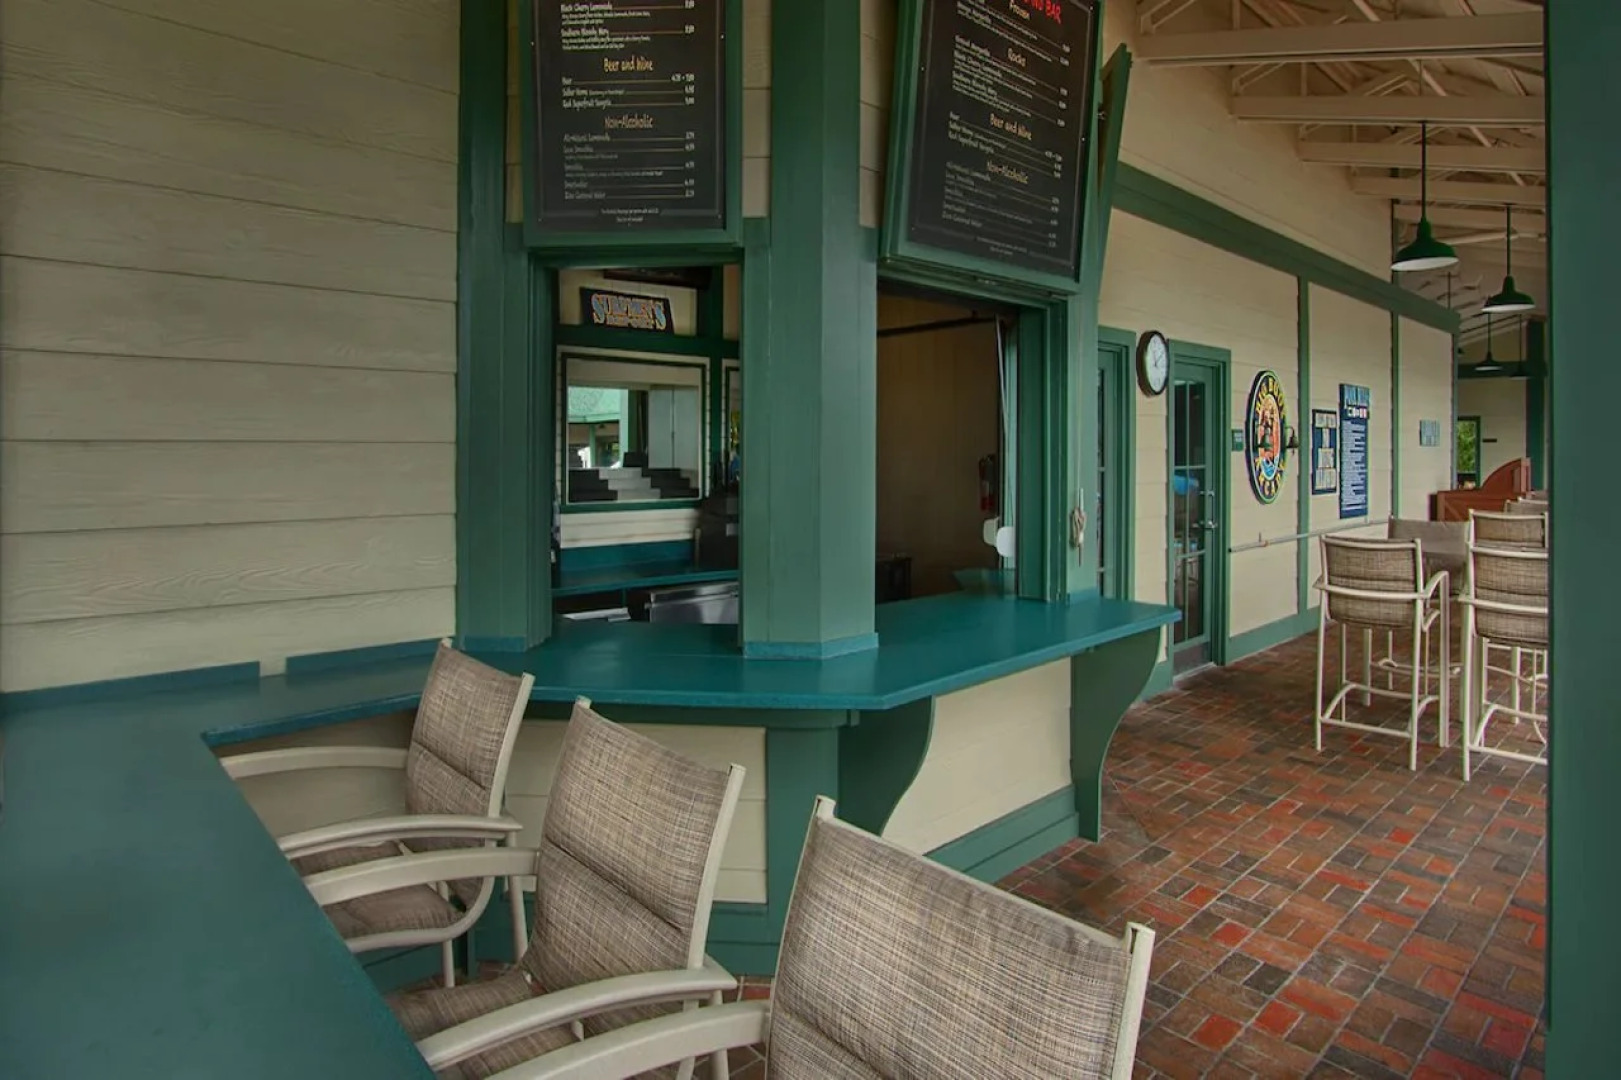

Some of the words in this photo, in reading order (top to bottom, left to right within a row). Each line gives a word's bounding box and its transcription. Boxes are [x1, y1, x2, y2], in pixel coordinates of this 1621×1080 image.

[603, 57, 619, 72] Beer
[621, 55, 634, 71] and
[636, 55, 653, 71] Wine
[604, 113, 653, 129] Non-Alcoholic
[989, 113, 1004, 129] Beer
[1005, 121, 1018, 134] and
